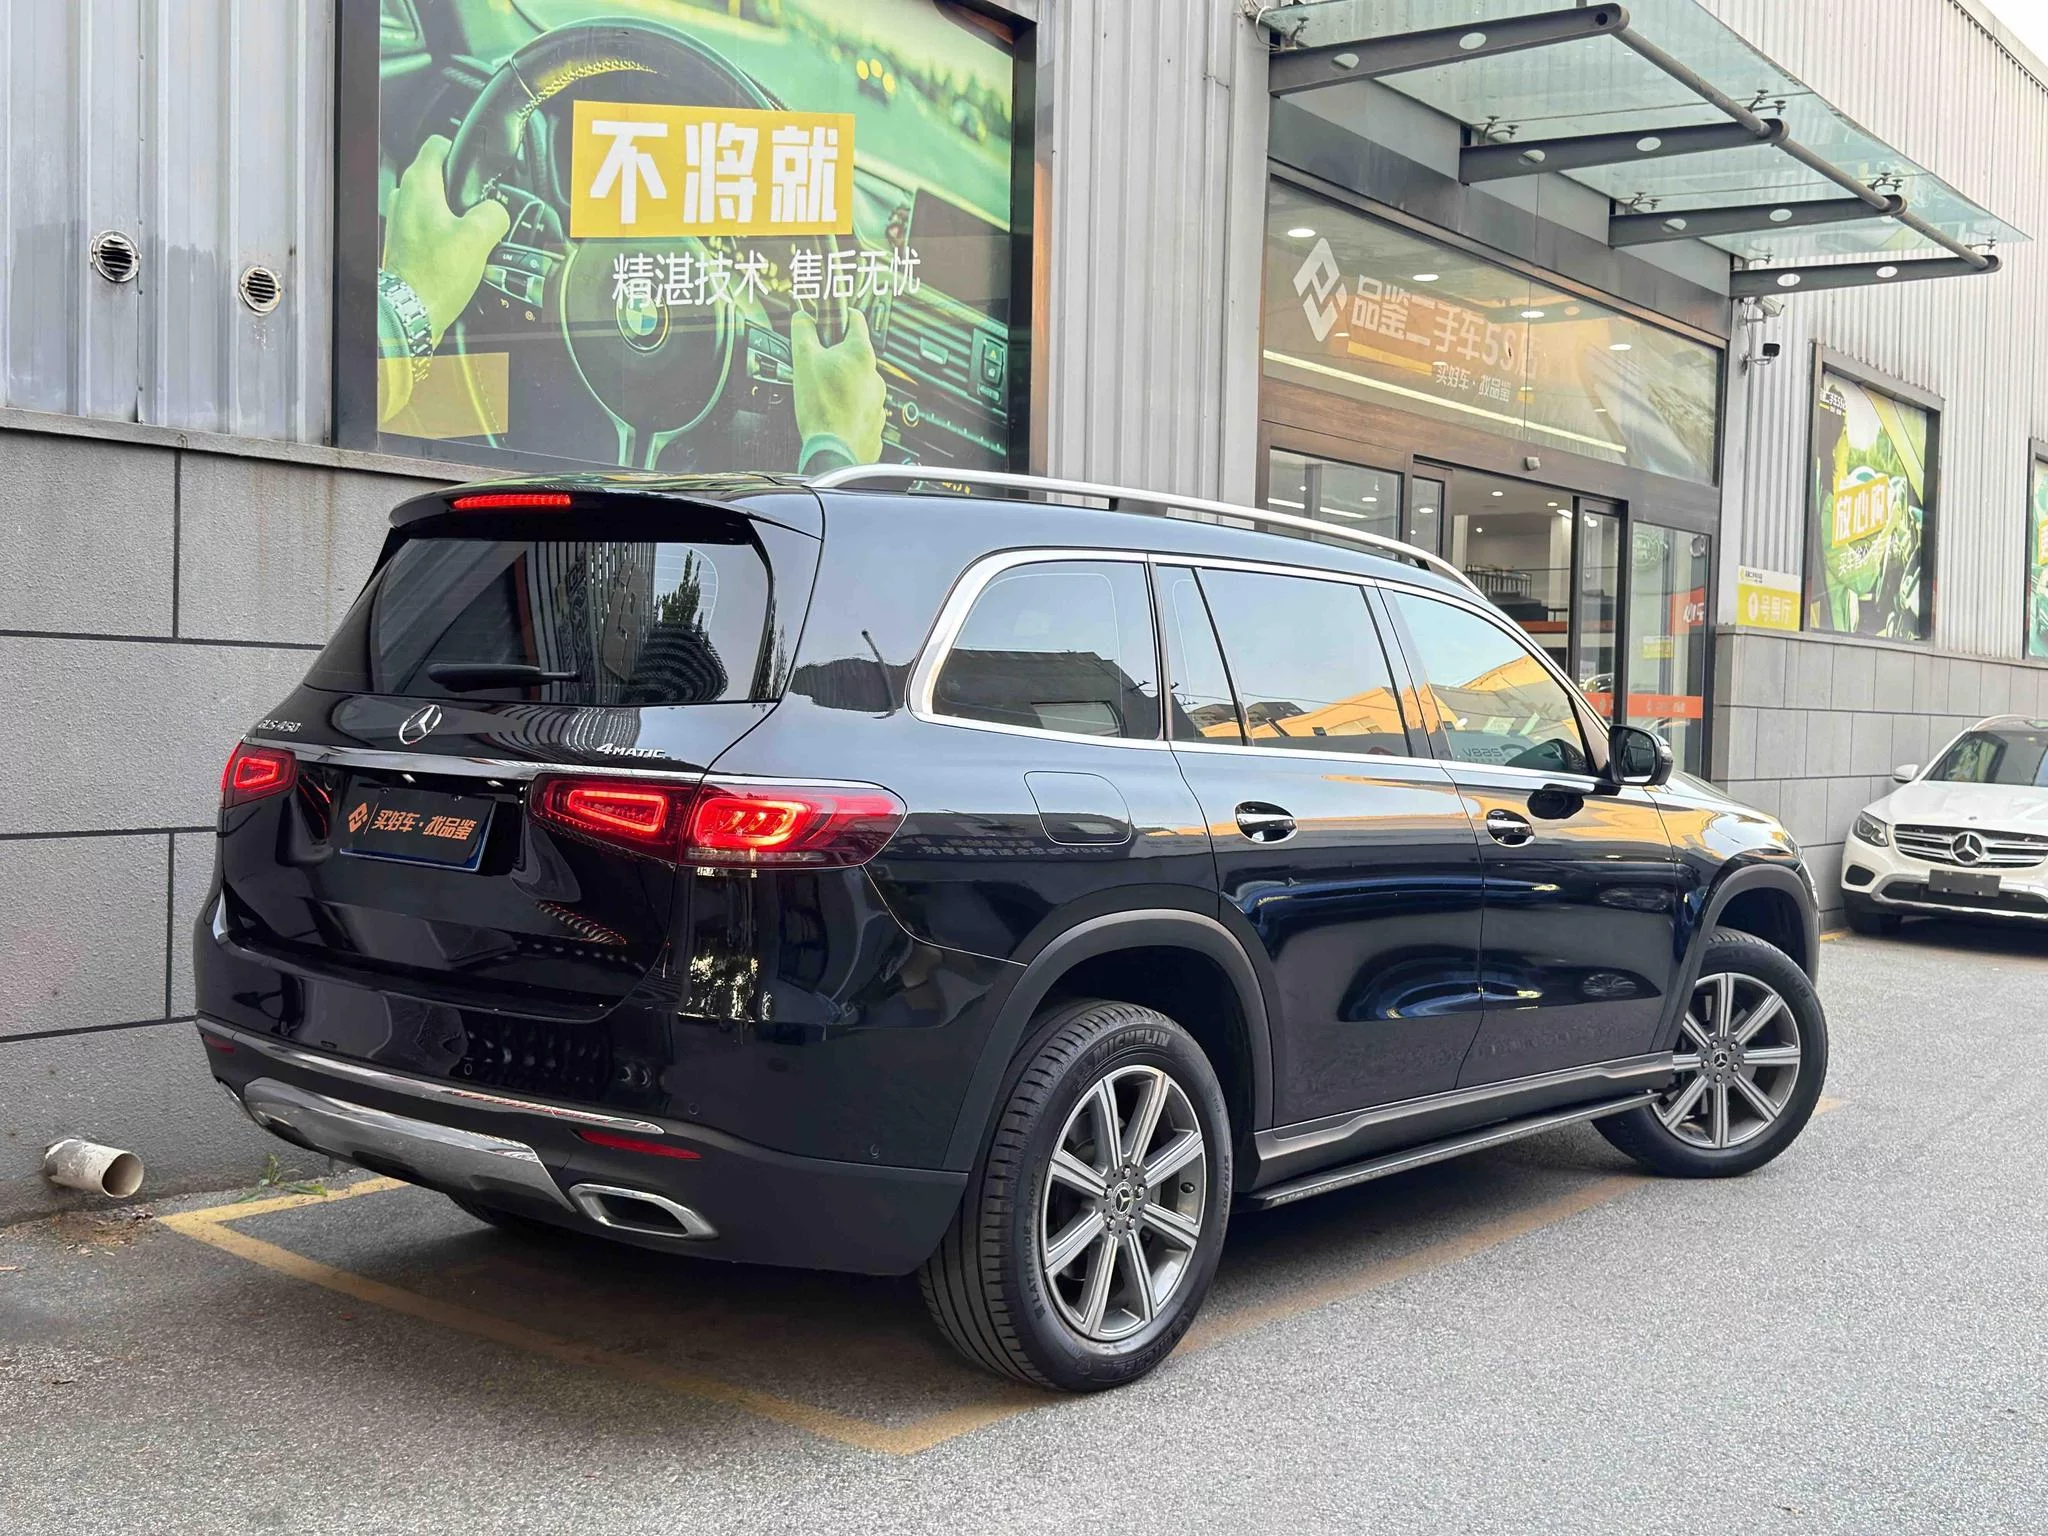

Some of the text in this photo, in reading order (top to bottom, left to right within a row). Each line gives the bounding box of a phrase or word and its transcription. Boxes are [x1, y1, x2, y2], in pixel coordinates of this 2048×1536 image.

[590, 120, 838, 224] 不将就
[611, 246, 921, 309] 精湛技术 售后无忧
[596, 742, 667, 759] 4MATIC
[1093, 1029, 1171, 1065] MICHELIN
